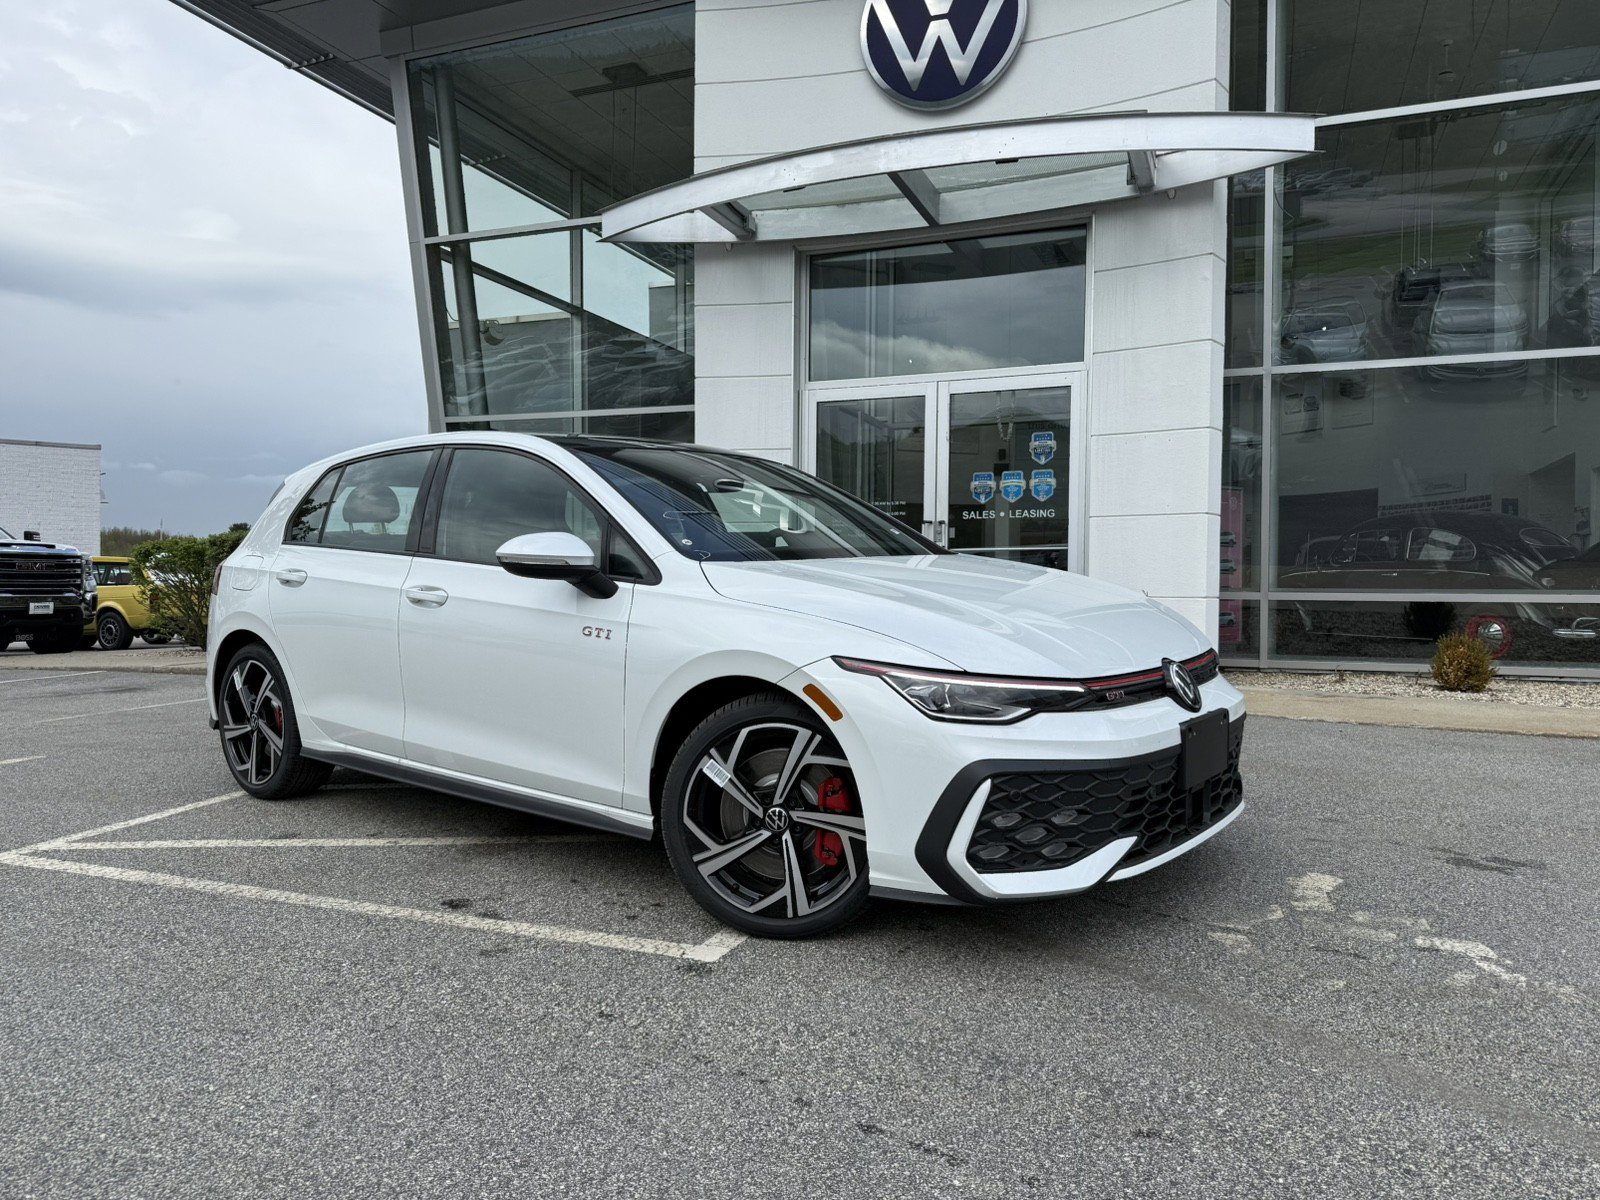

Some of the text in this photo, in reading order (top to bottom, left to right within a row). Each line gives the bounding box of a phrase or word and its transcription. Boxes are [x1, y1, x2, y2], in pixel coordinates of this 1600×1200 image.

[962, 509, 1055, 519] SALES LEASING
[582, 625, 612, 640] GTI
